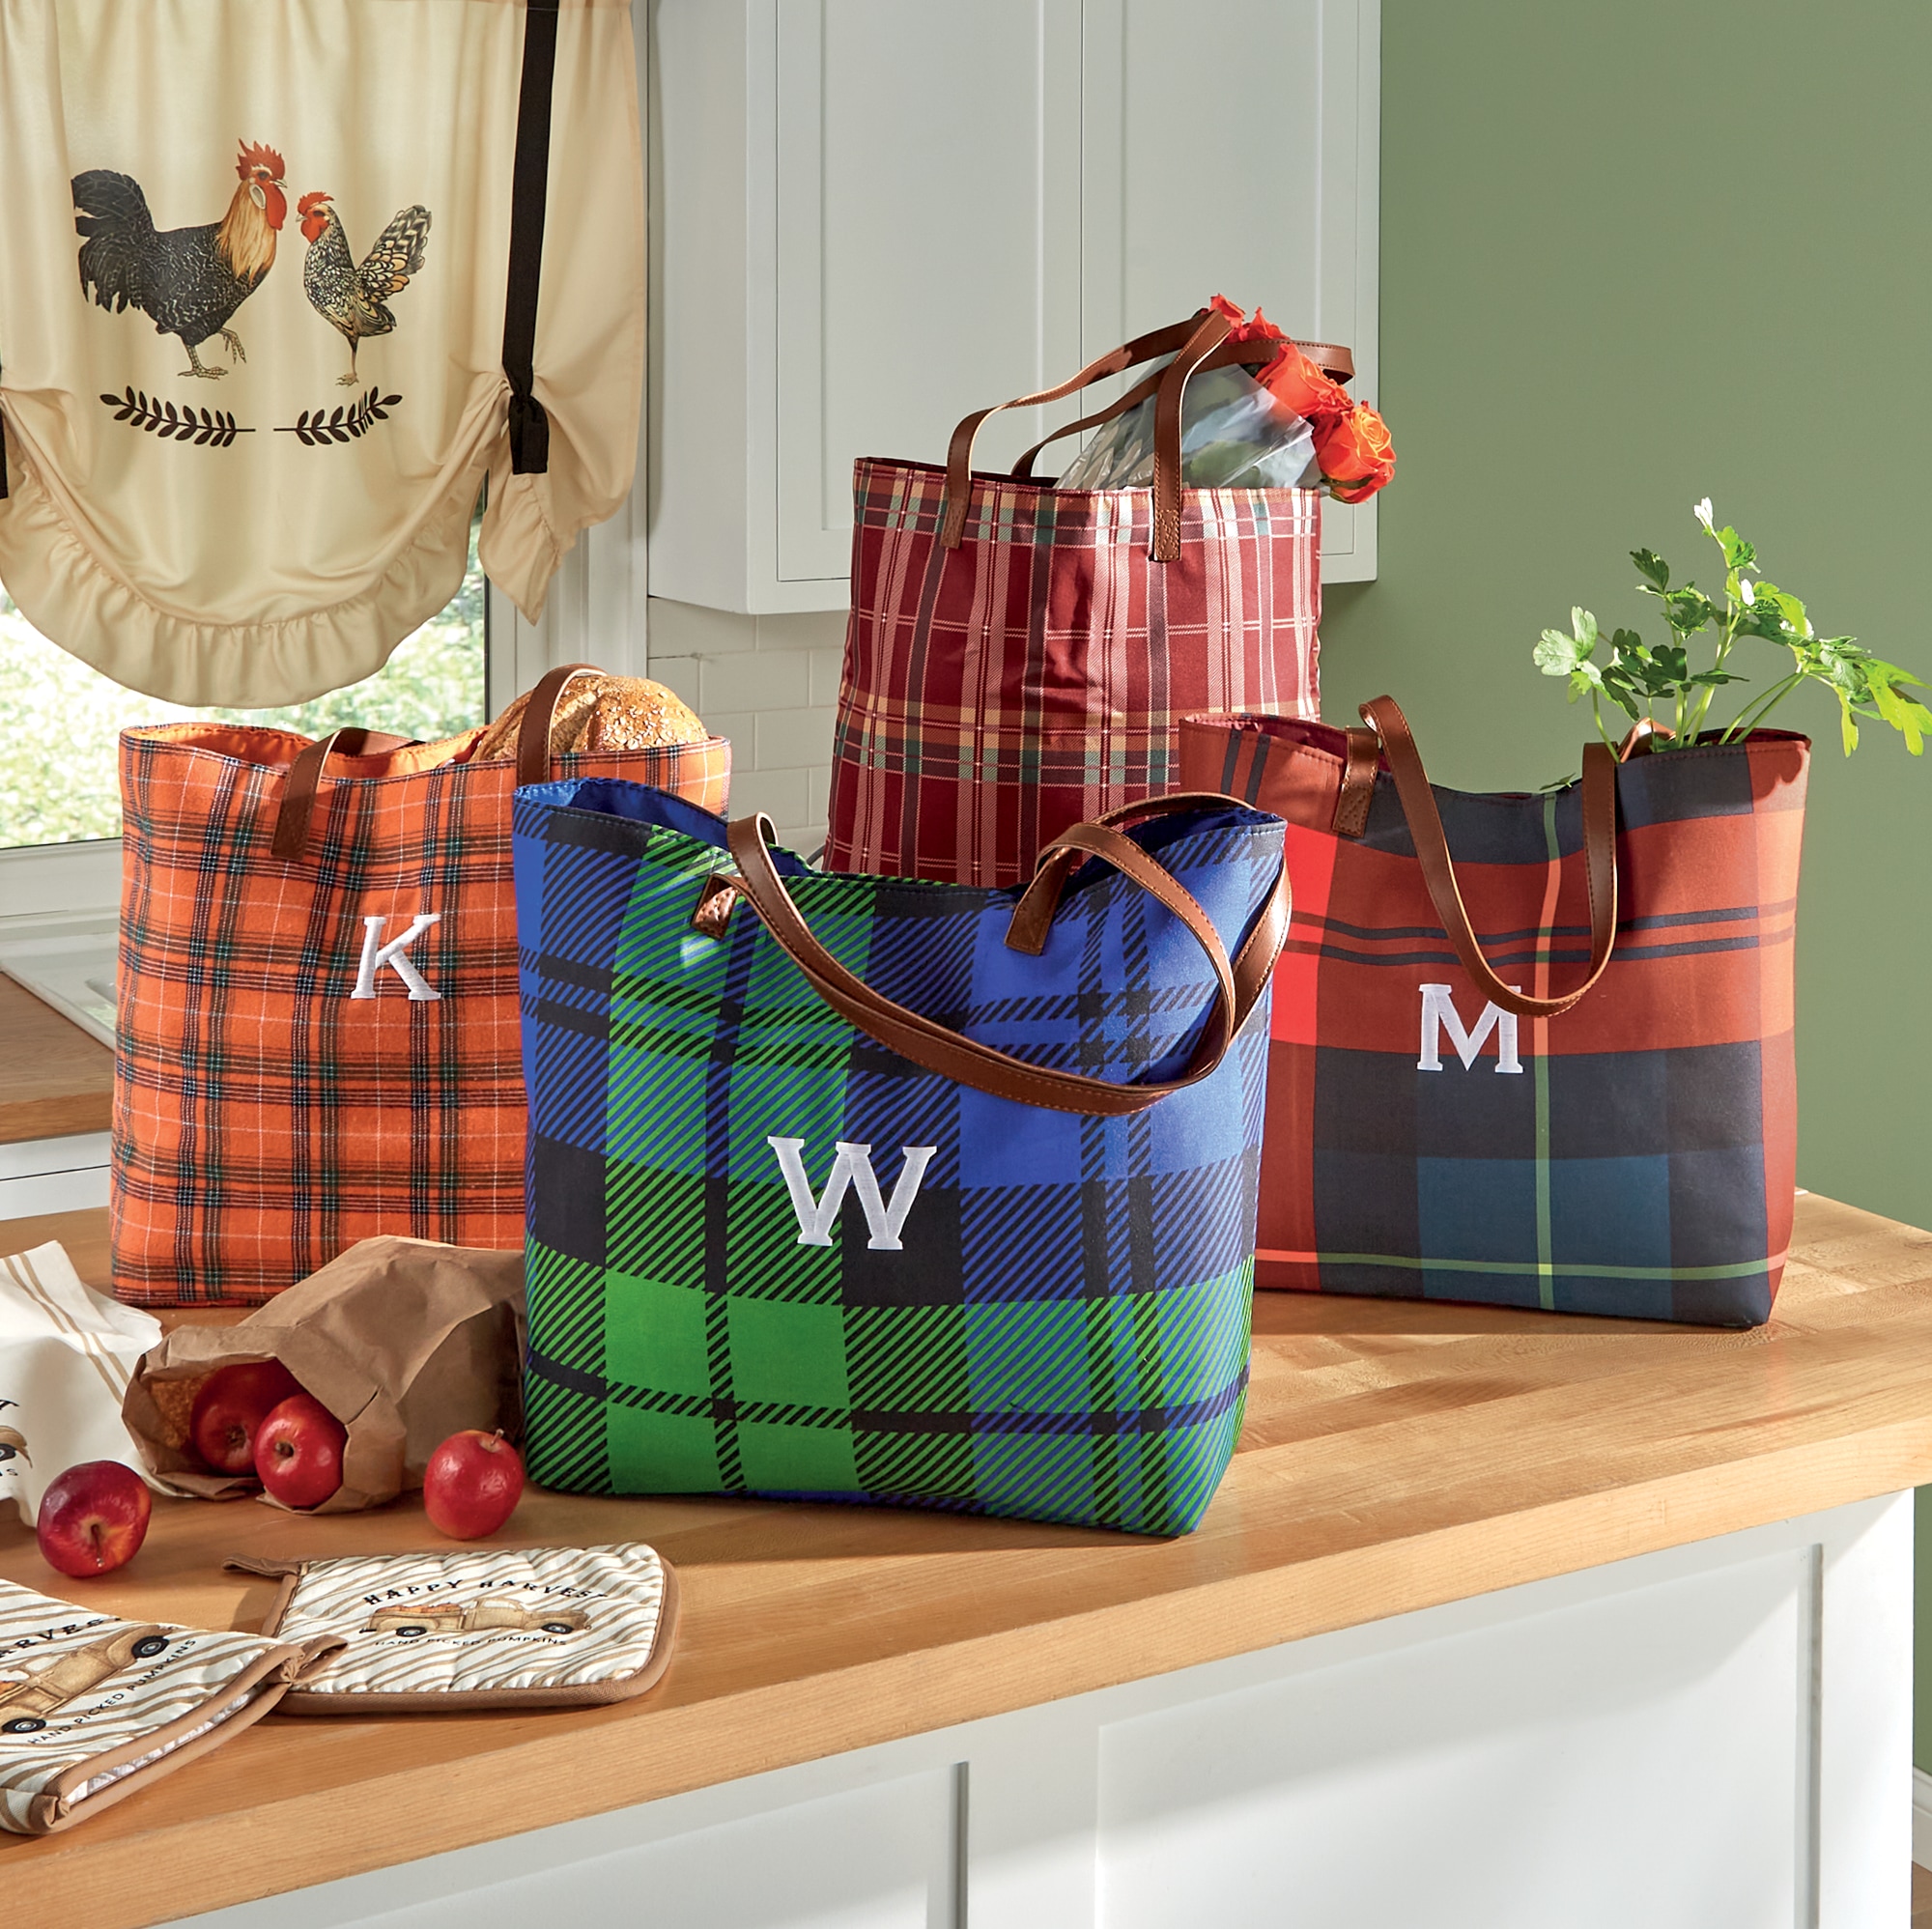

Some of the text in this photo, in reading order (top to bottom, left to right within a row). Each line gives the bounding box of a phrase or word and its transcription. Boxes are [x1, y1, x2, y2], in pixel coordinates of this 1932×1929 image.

[351, 914, 441, 1001] K
[1417, 983, 1523, 1073] M
[767, 1135, 937, 1250] W
[363, 1579, 463, 1605] HAPPY
[27, 1639, 196, 1745] HAND PICKED PUMPKINS
